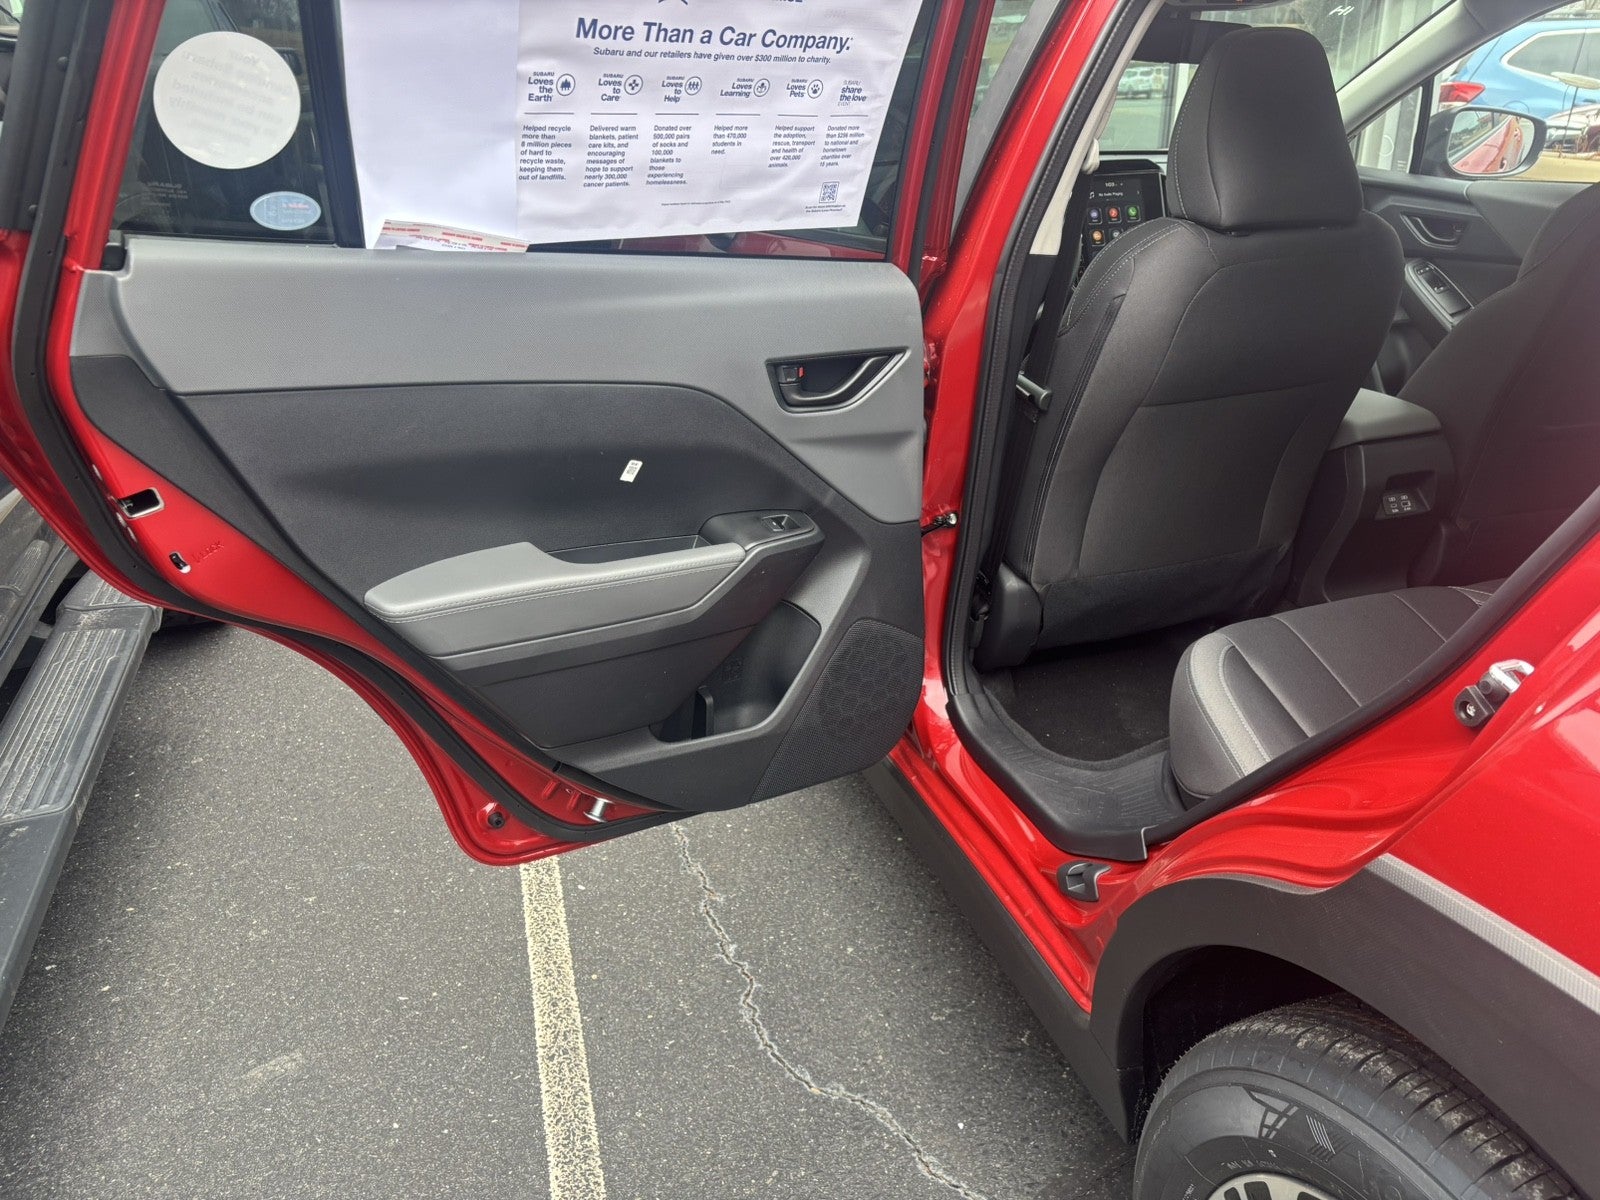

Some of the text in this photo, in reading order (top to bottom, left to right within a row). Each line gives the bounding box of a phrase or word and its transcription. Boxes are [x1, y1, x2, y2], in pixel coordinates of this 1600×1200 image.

[576, 17, 634, 41] More
[643, 21, 694, 44] Than
[700, 29, 712, 44] a
[719, 26, 756, 47] Car
[593, 47, 624, 56] Subaru
[626, 48, 642, 58] and
[660, 50, 692, 59] retailers
[693, 51, 712, 60] have
[713, 52, 735, 62] given
[754, 54, 772, 62] $300
[772, 55, 797, 63] million
[806, 56, 831, 66] charity.
[528, 77, 554, 86] Loves
[598, 78, 622, 87] Loves
[539, 86, 553, 94] the
[720, 89, 751, 98] Learning
[528, 93, 552, 102] Earth
[601, 94, 620, 102] Care
[664, 95, 681, 104] Help
